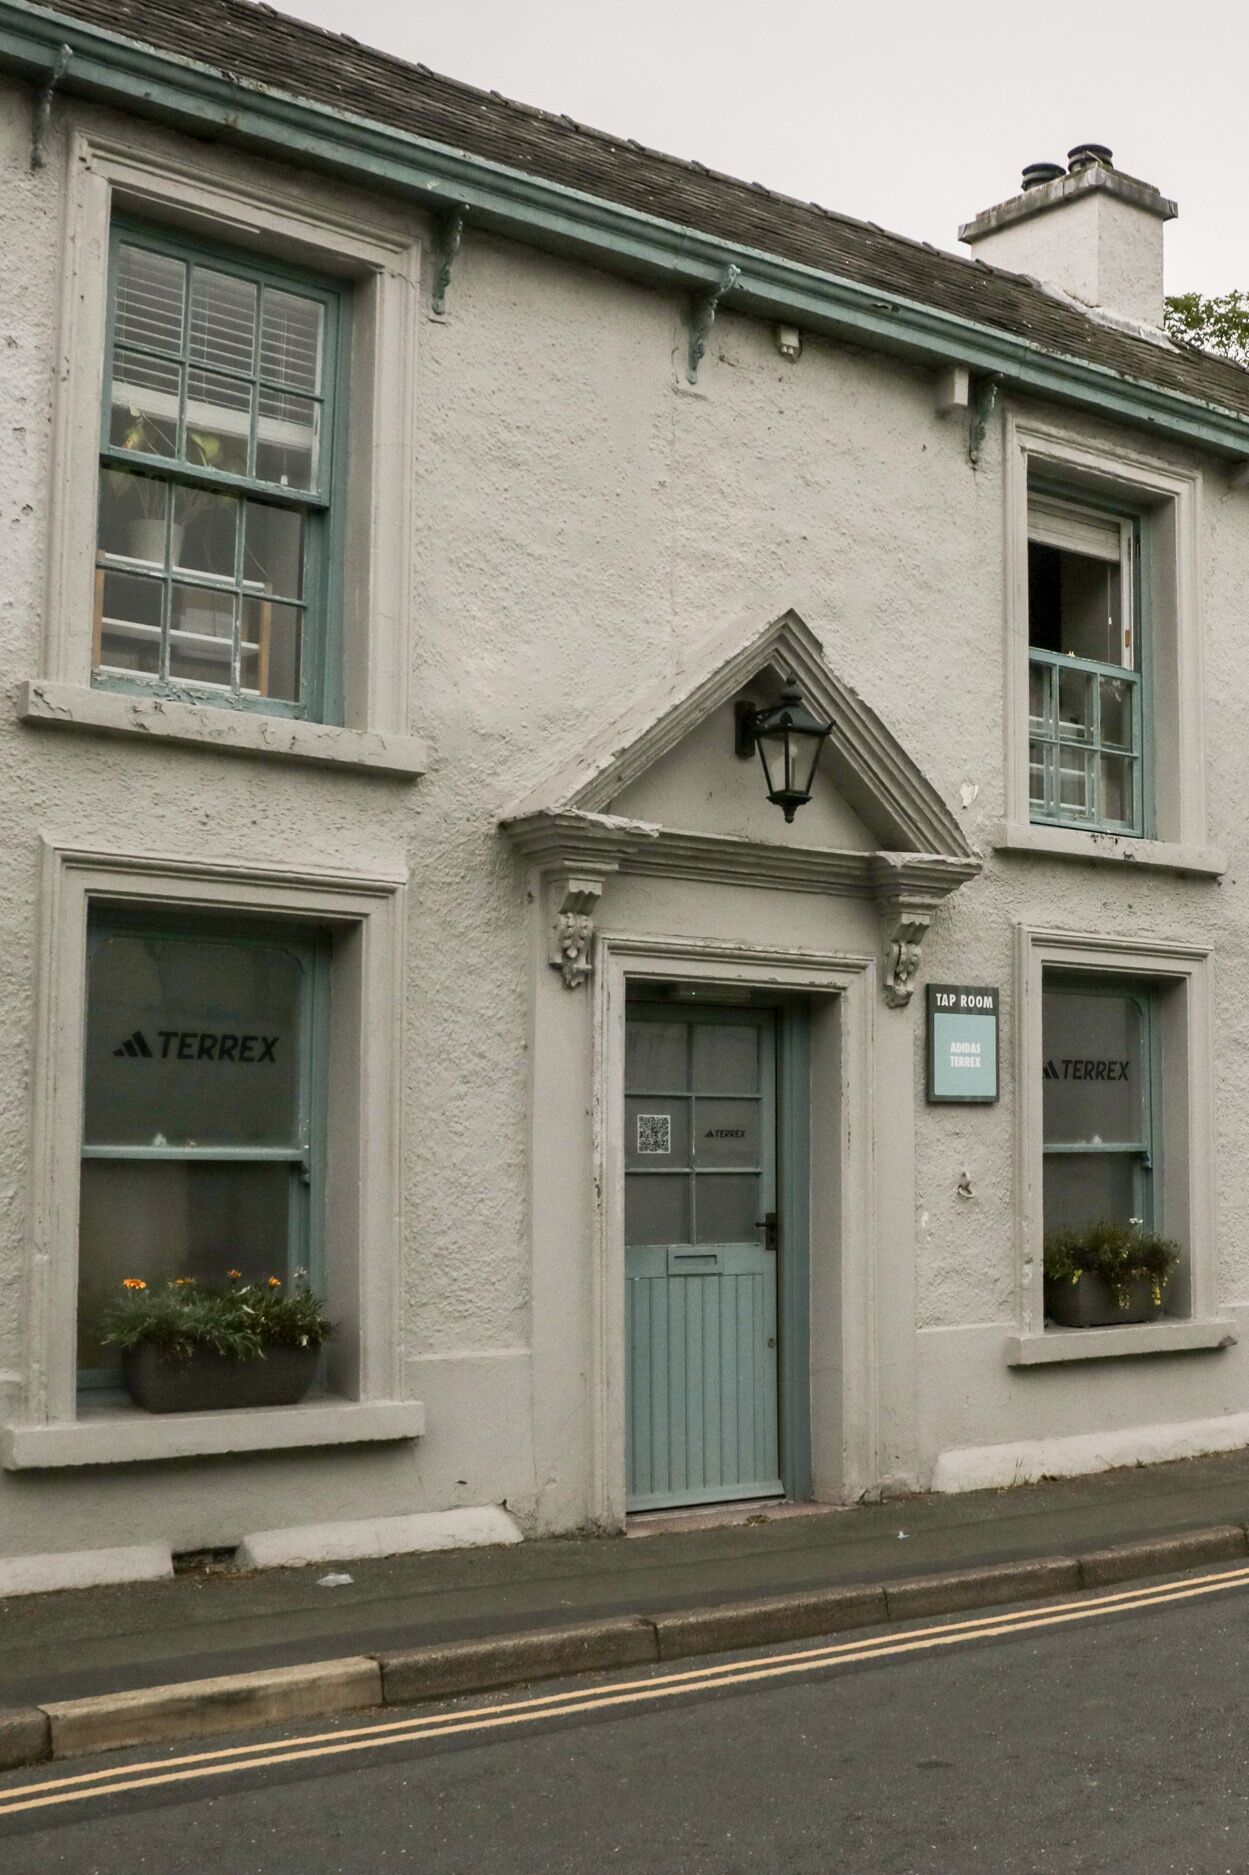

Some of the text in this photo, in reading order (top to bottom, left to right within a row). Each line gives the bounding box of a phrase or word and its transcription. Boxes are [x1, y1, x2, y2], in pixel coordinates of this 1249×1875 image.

[936, 992, 994, 1009] TAP ROOM
[158, 1030, 280, 1064] TERREX
[950, 1041, 981, 1054] ADIDAS
[950, 1055, 981, 1068] TERREX
[1061, 1059, 1130, 1082] TERREX
[715, 1129, 746, 1138] TERREX
